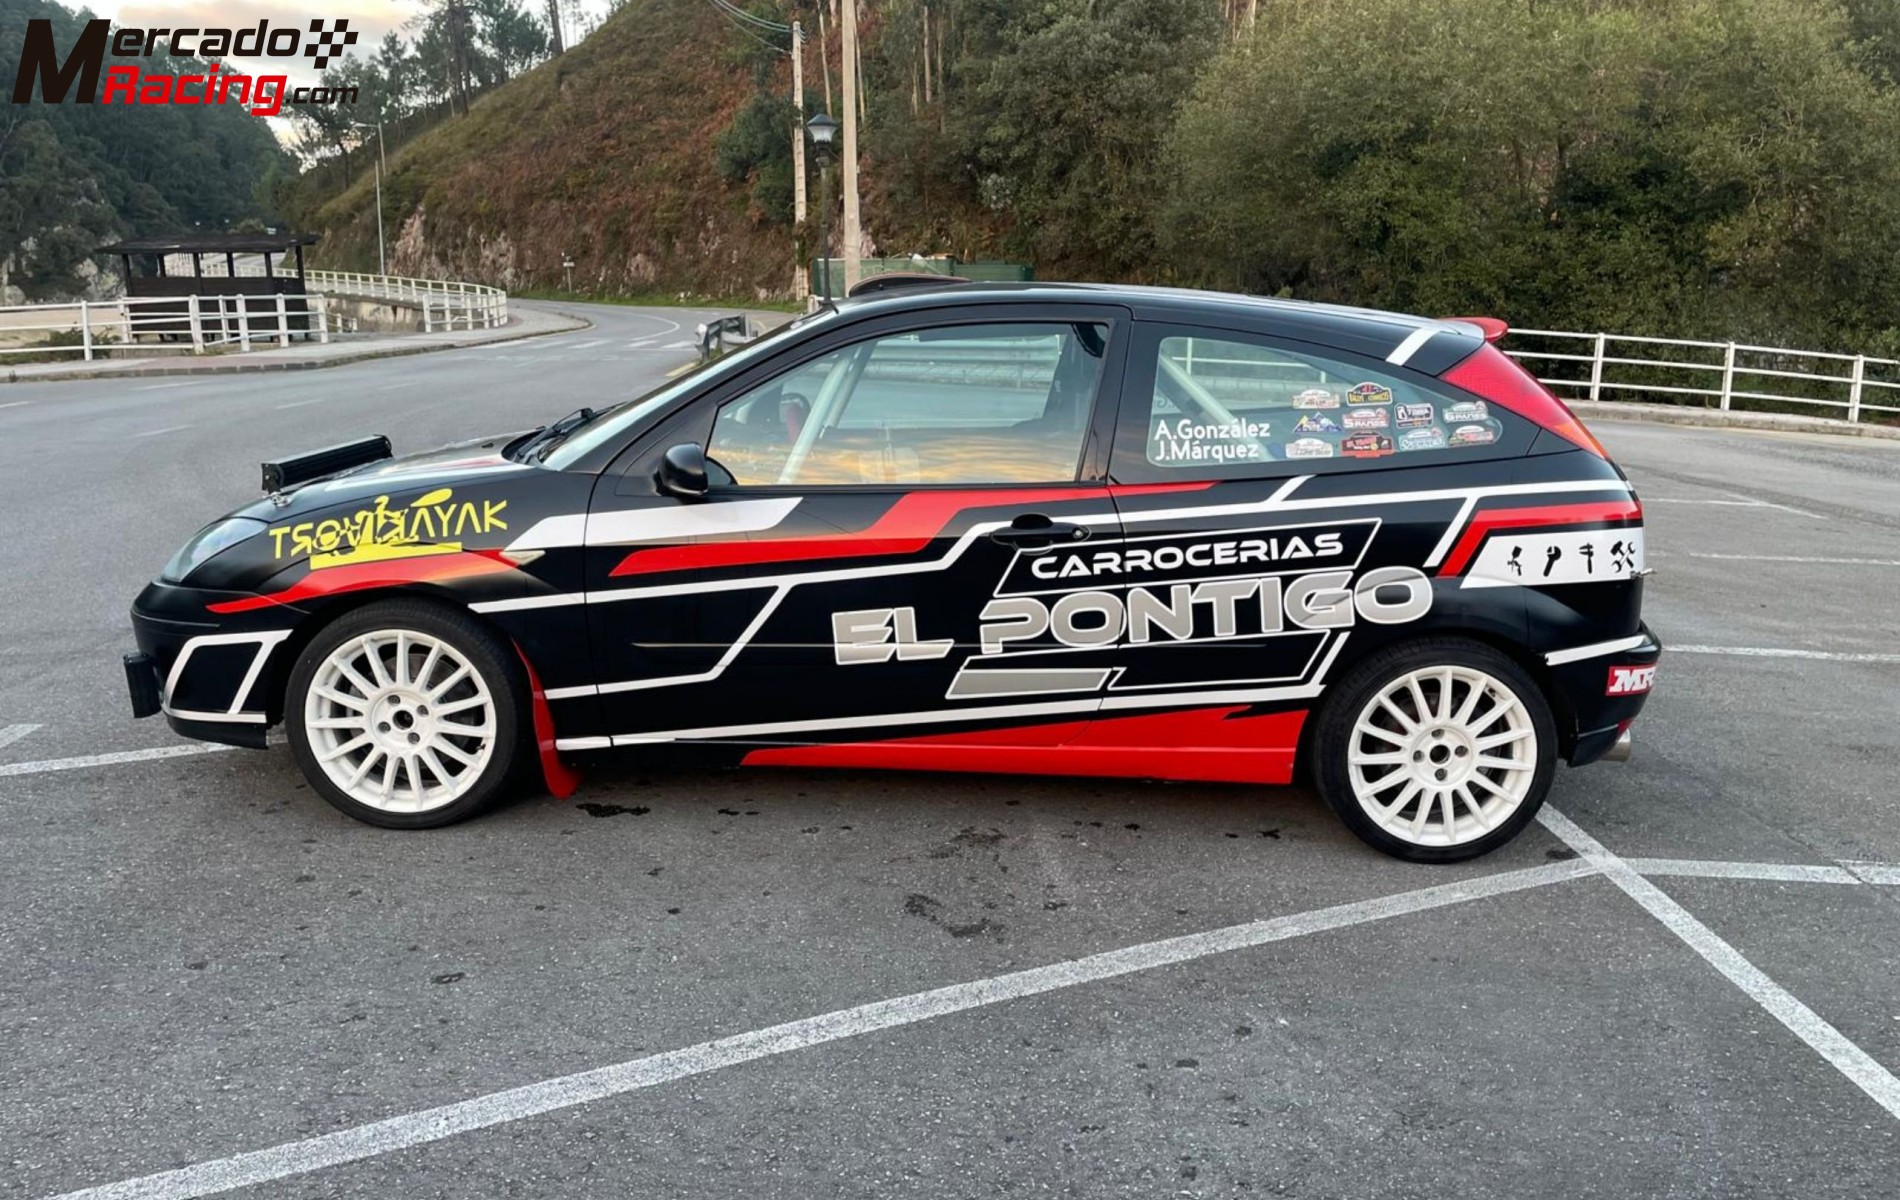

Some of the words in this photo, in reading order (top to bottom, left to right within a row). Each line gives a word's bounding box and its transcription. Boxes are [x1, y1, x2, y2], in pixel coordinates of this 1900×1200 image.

[1154, 440, 1260, 463] J.Márquez
[1031, 532, 1343, 579] CARROCERIAS
[832, 607, 955, 666] EL
[979, 565, 1433, 655] PONTIGO
